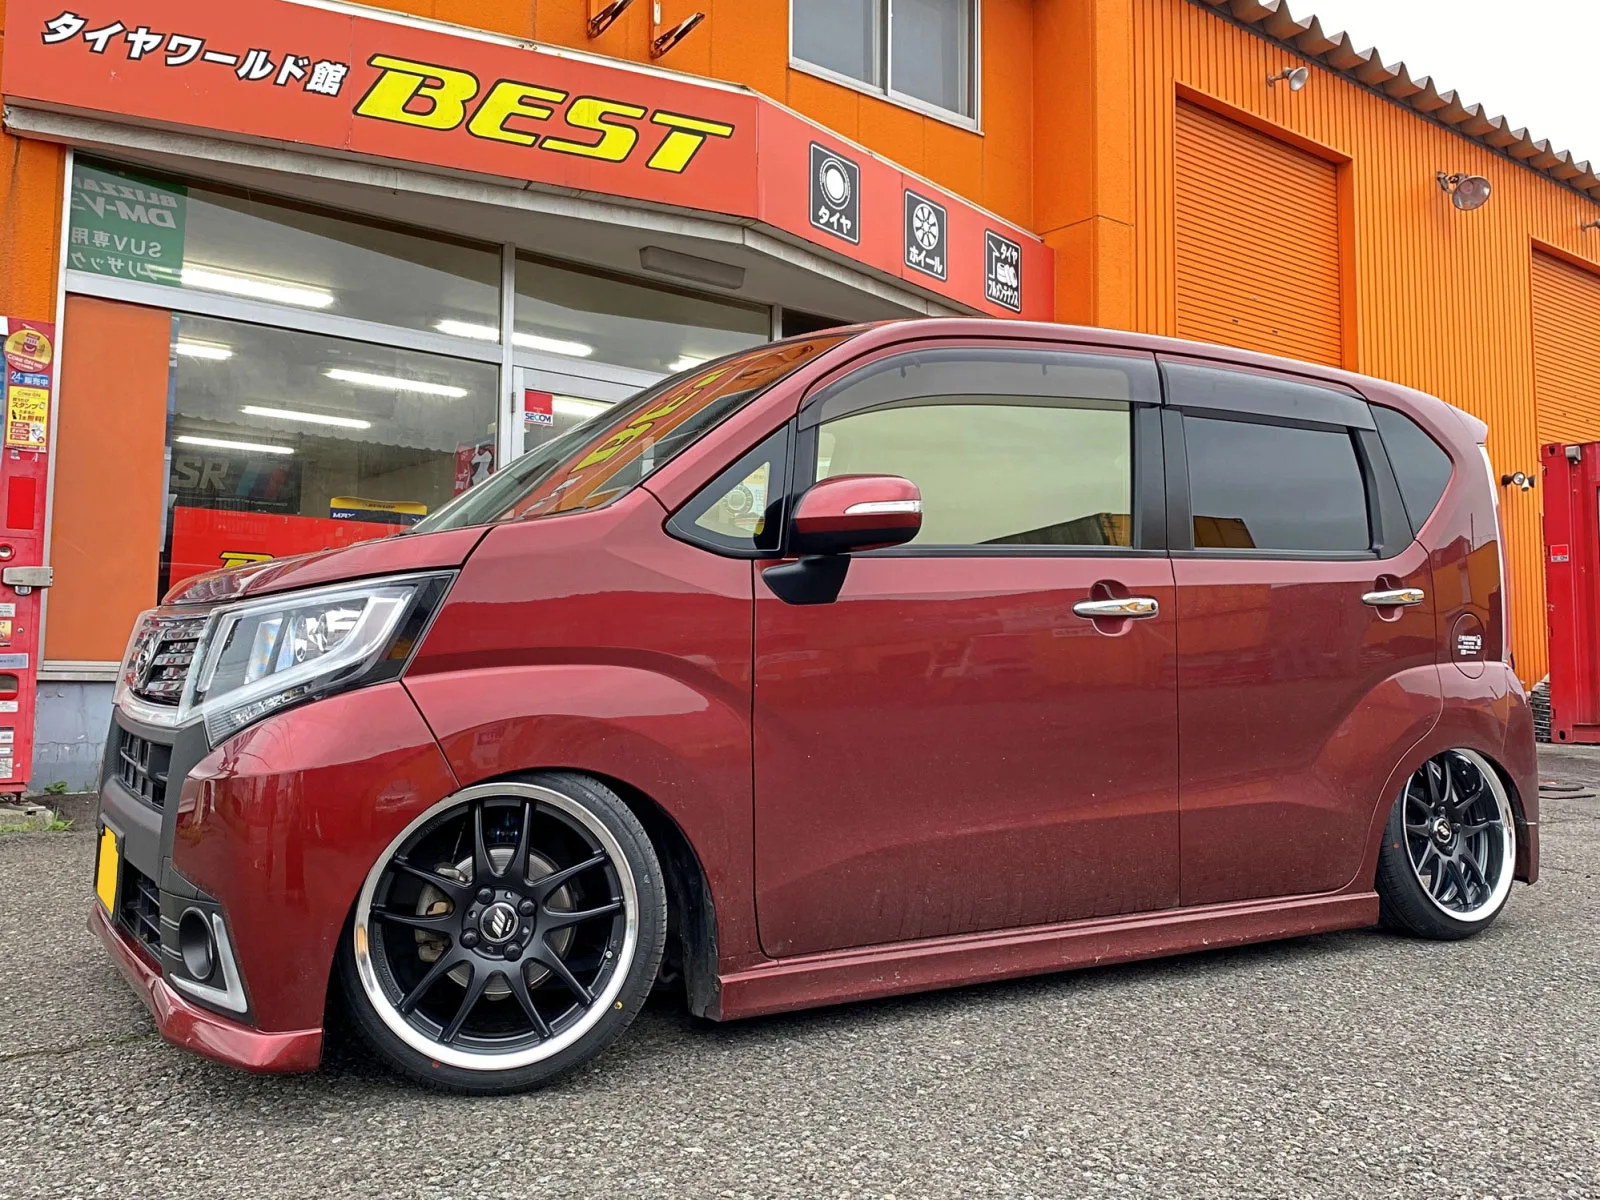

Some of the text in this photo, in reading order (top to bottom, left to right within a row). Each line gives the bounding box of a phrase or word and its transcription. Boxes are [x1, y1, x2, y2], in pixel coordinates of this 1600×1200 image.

[41, 10, 350, 97] タイヤワールド館
[353, 53, 735, 174] BEST
[818, 205, 851, 234] タイヤ
[909, 245, 943, 274] ホイール
[1000, 243, 1018, 265] タイヤ
[524, 412, 552, 423] SECOM
